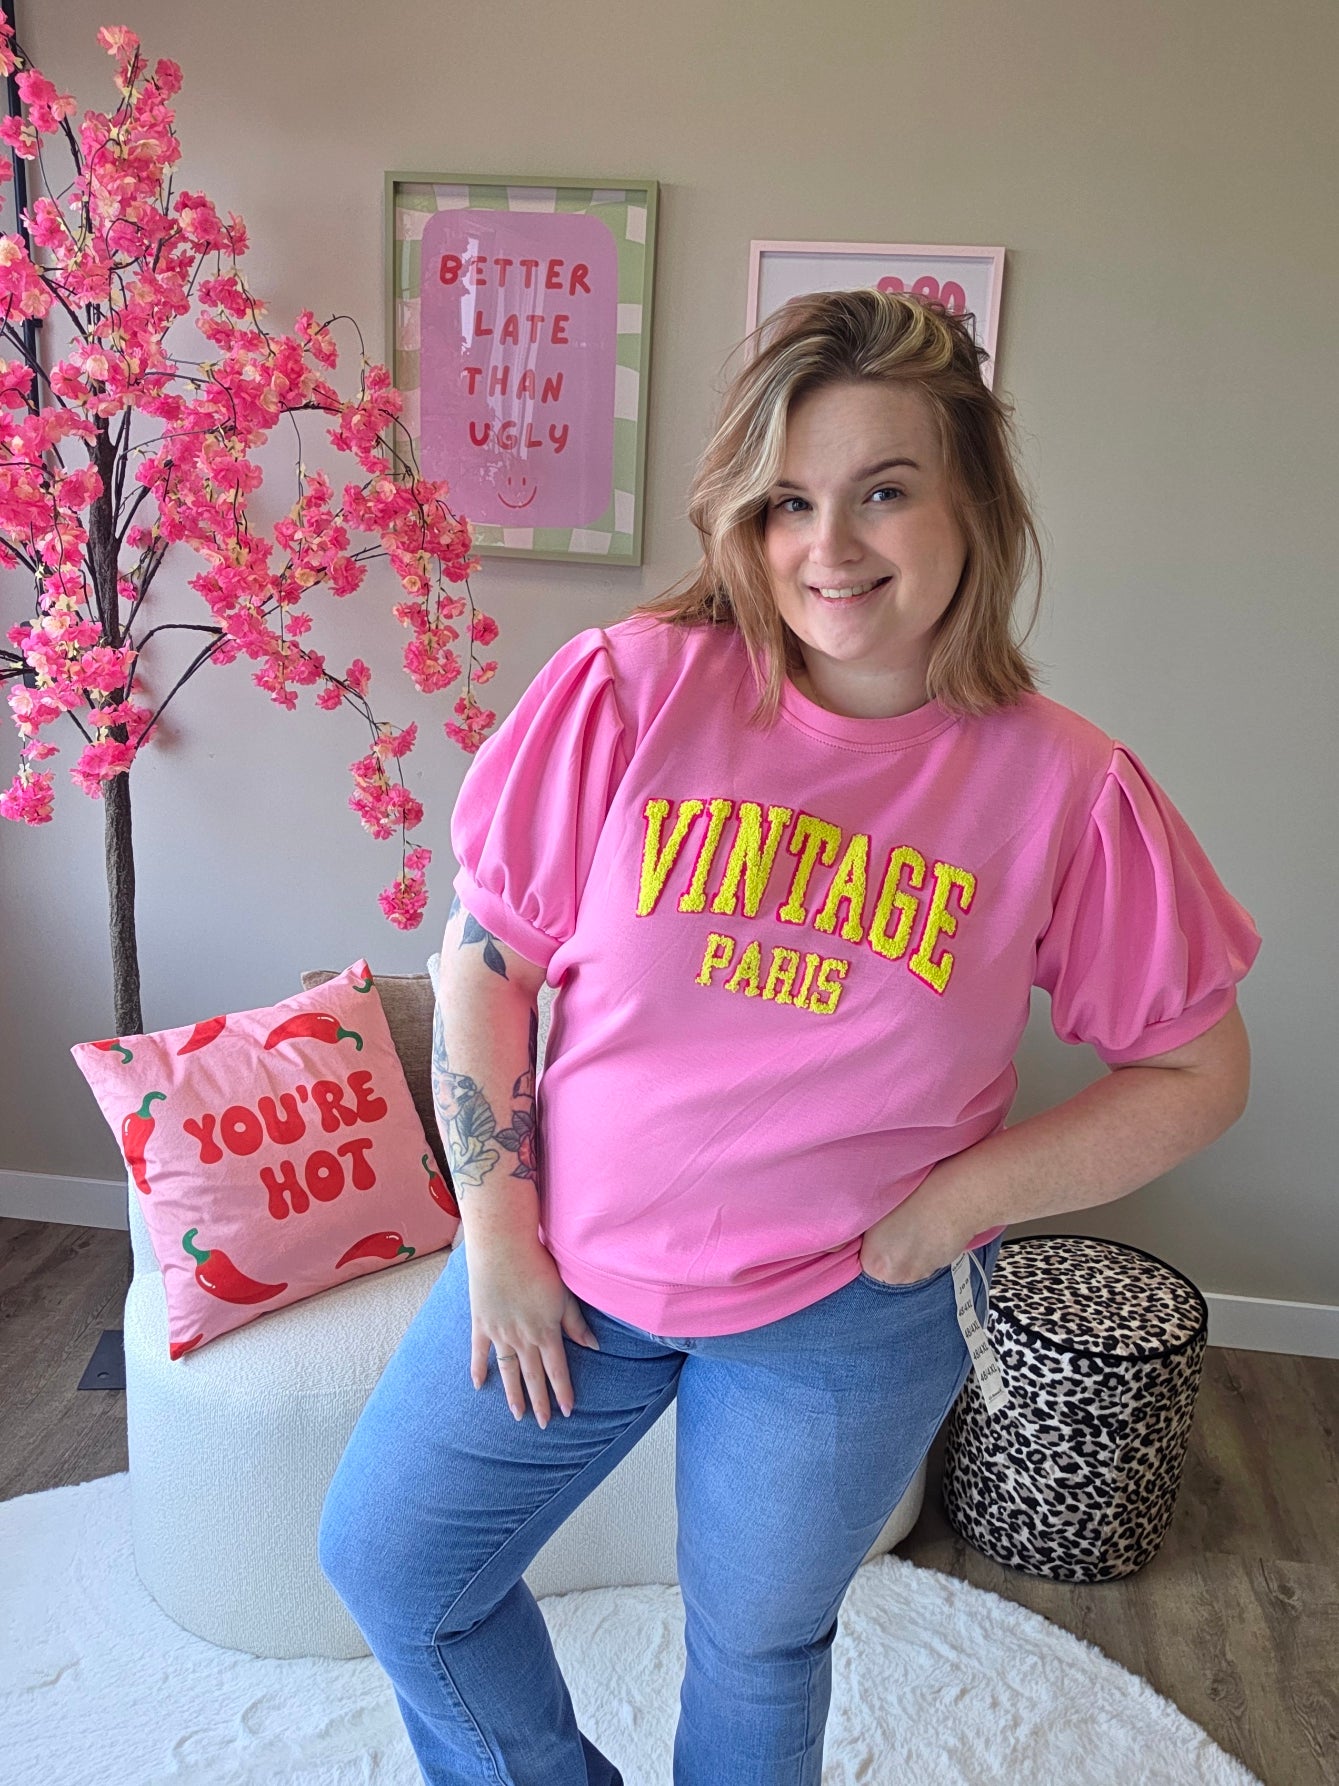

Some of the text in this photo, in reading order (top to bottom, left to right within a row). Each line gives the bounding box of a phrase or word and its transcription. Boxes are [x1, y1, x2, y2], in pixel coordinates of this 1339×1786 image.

[439, 254, 591, 296] BETTER
[474, 311, 570, 346] LATE
[463, 366, 564, 404] THAN
[469, 420, 570, 454] UGLY
[636, 797, 978, 996] VINTAGE
[694, 931, 850, 1015] PARIS
[183, 1070, 388, 1164] YOU'RE
[259, 1137, 377, 1220] HOT
